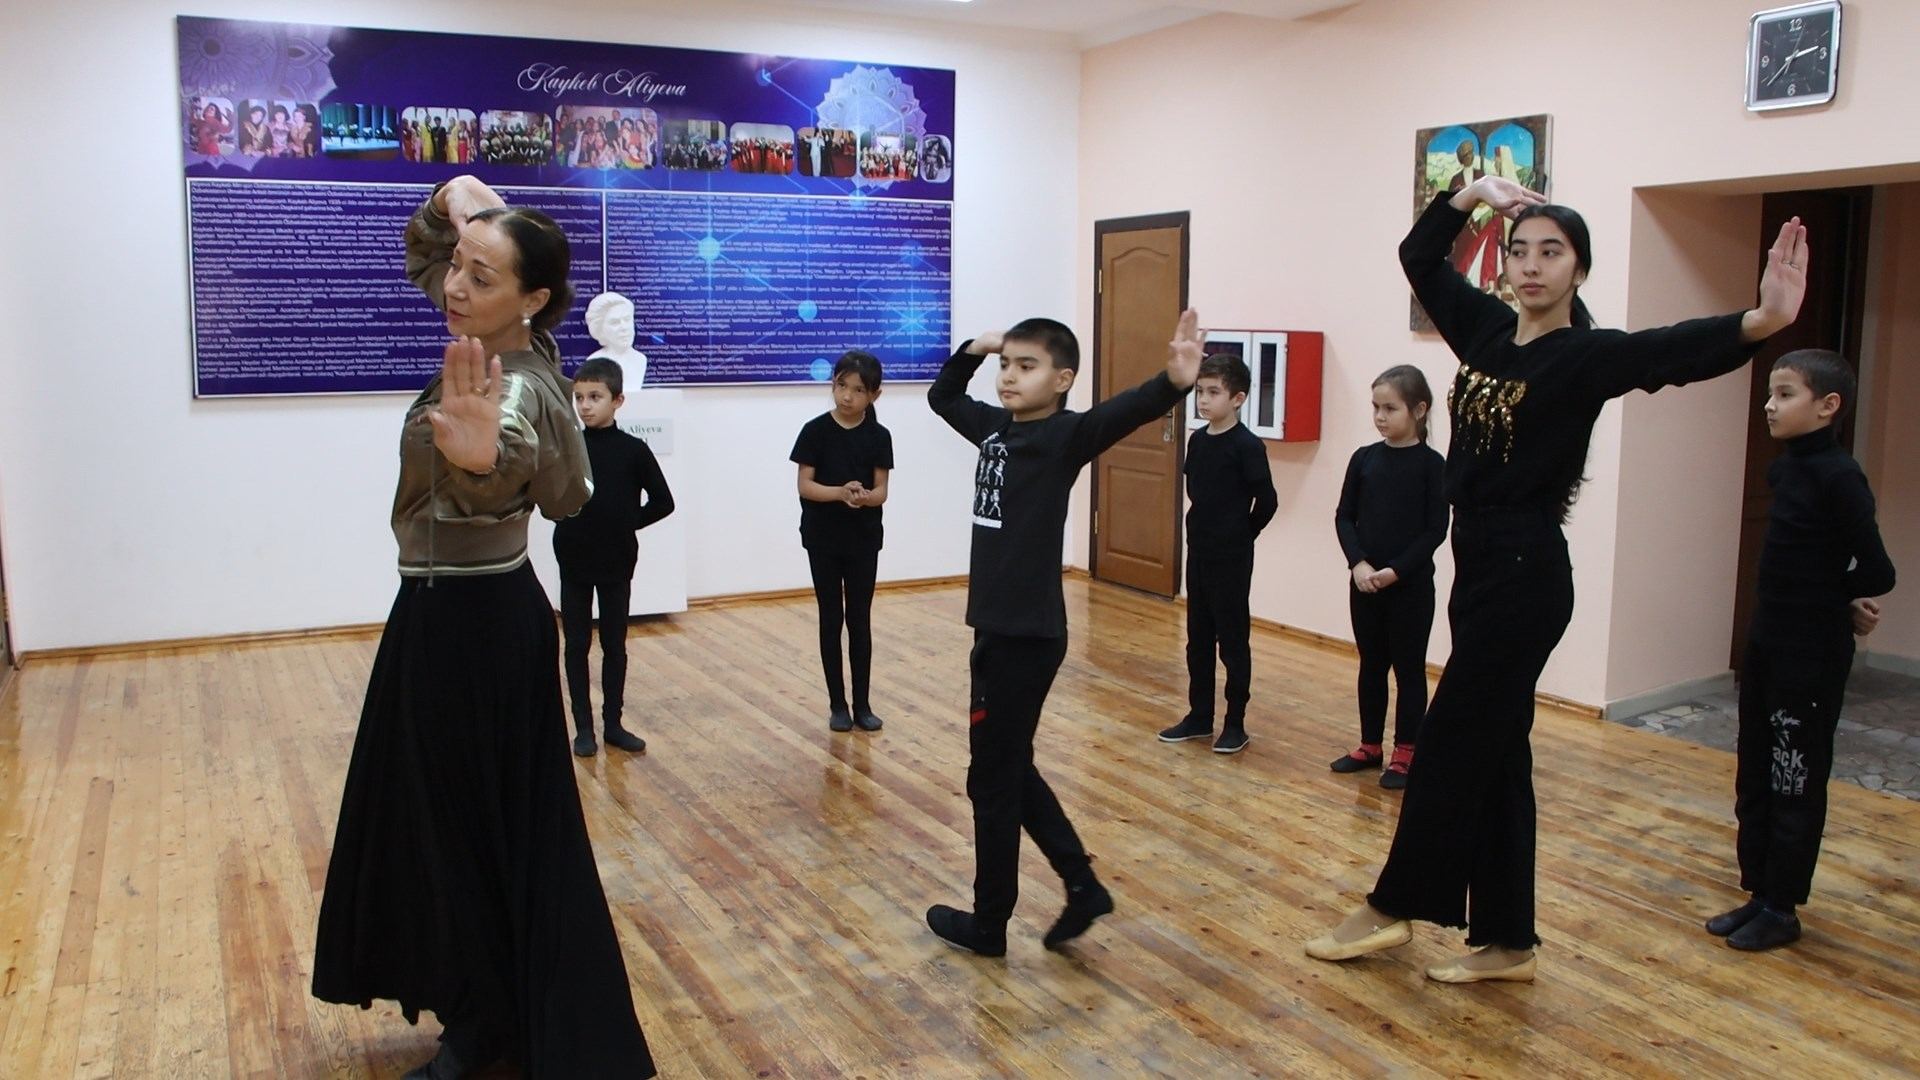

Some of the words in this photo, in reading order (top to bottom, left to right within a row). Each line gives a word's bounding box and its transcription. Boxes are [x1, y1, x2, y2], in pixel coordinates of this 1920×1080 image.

[1789, 18, 1803, 32] 12
[1820, 46, 1828, 60] 3
[1761, 55, 1770, 68] 9
[603, 68, 687, 102] Aliyeva
[1787, 83, 1797, 97] 6
